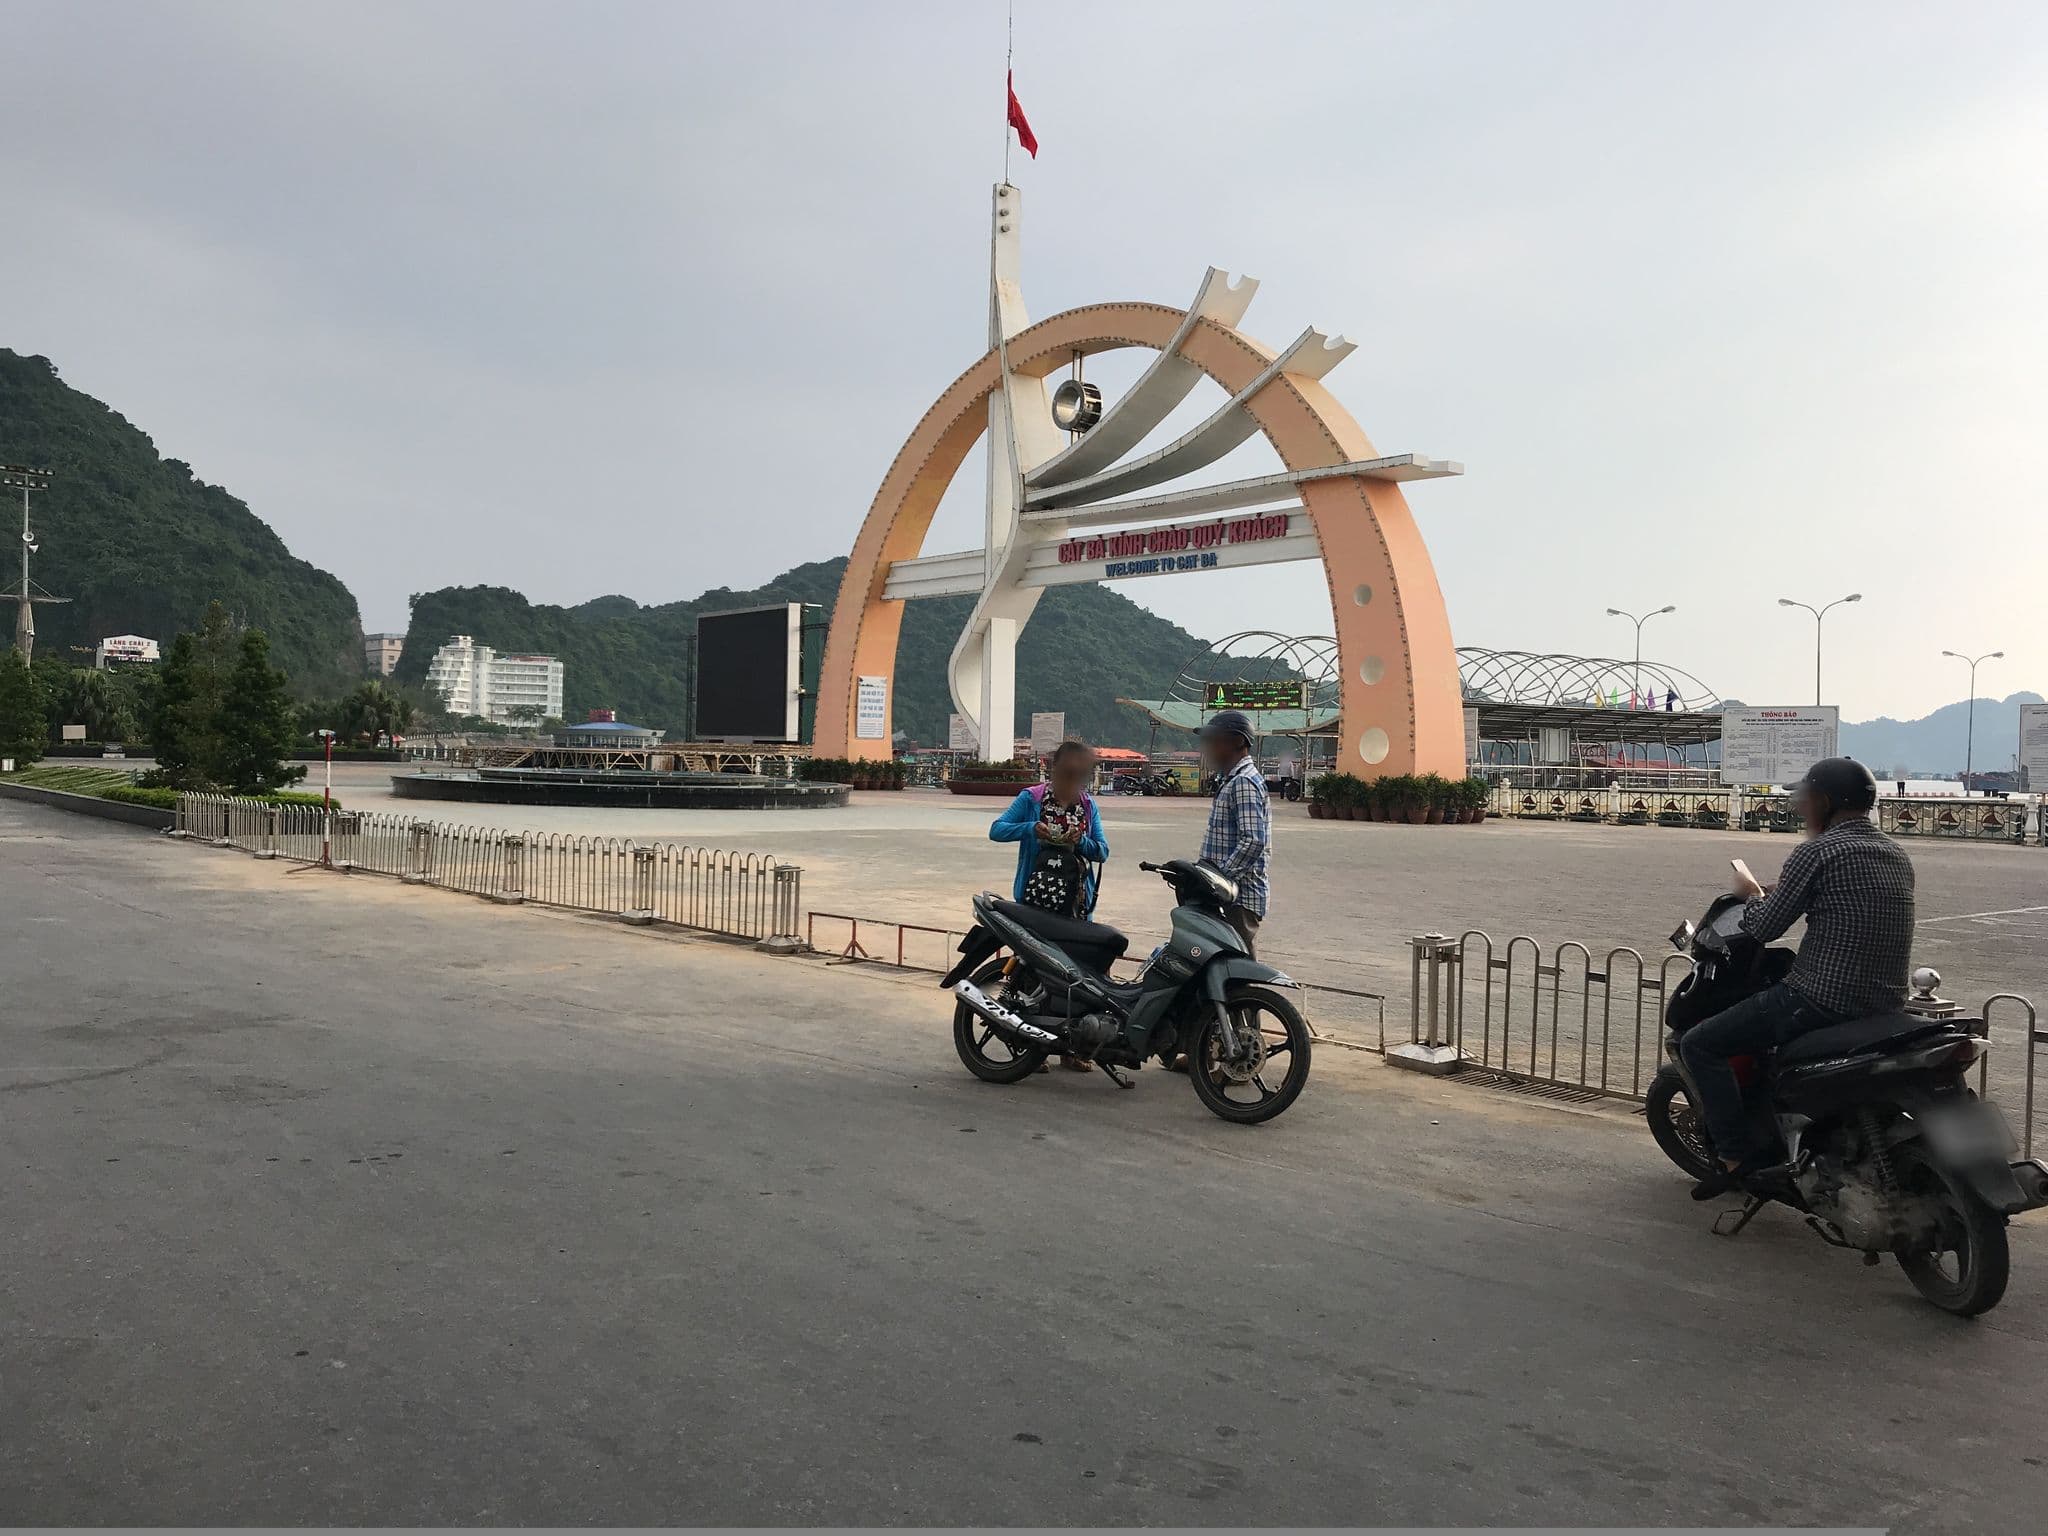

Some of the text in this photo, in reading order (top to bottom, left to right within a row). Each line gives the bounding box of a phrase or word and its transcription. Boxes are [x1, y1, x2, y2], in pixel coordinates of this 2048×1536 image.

[1058, 512, 1289, 563] CÁT BÀ KÍNH CHÀO QUÝ KHÁCH
[1105, 552, 1218, 577] WELCOME TO CAT BA
